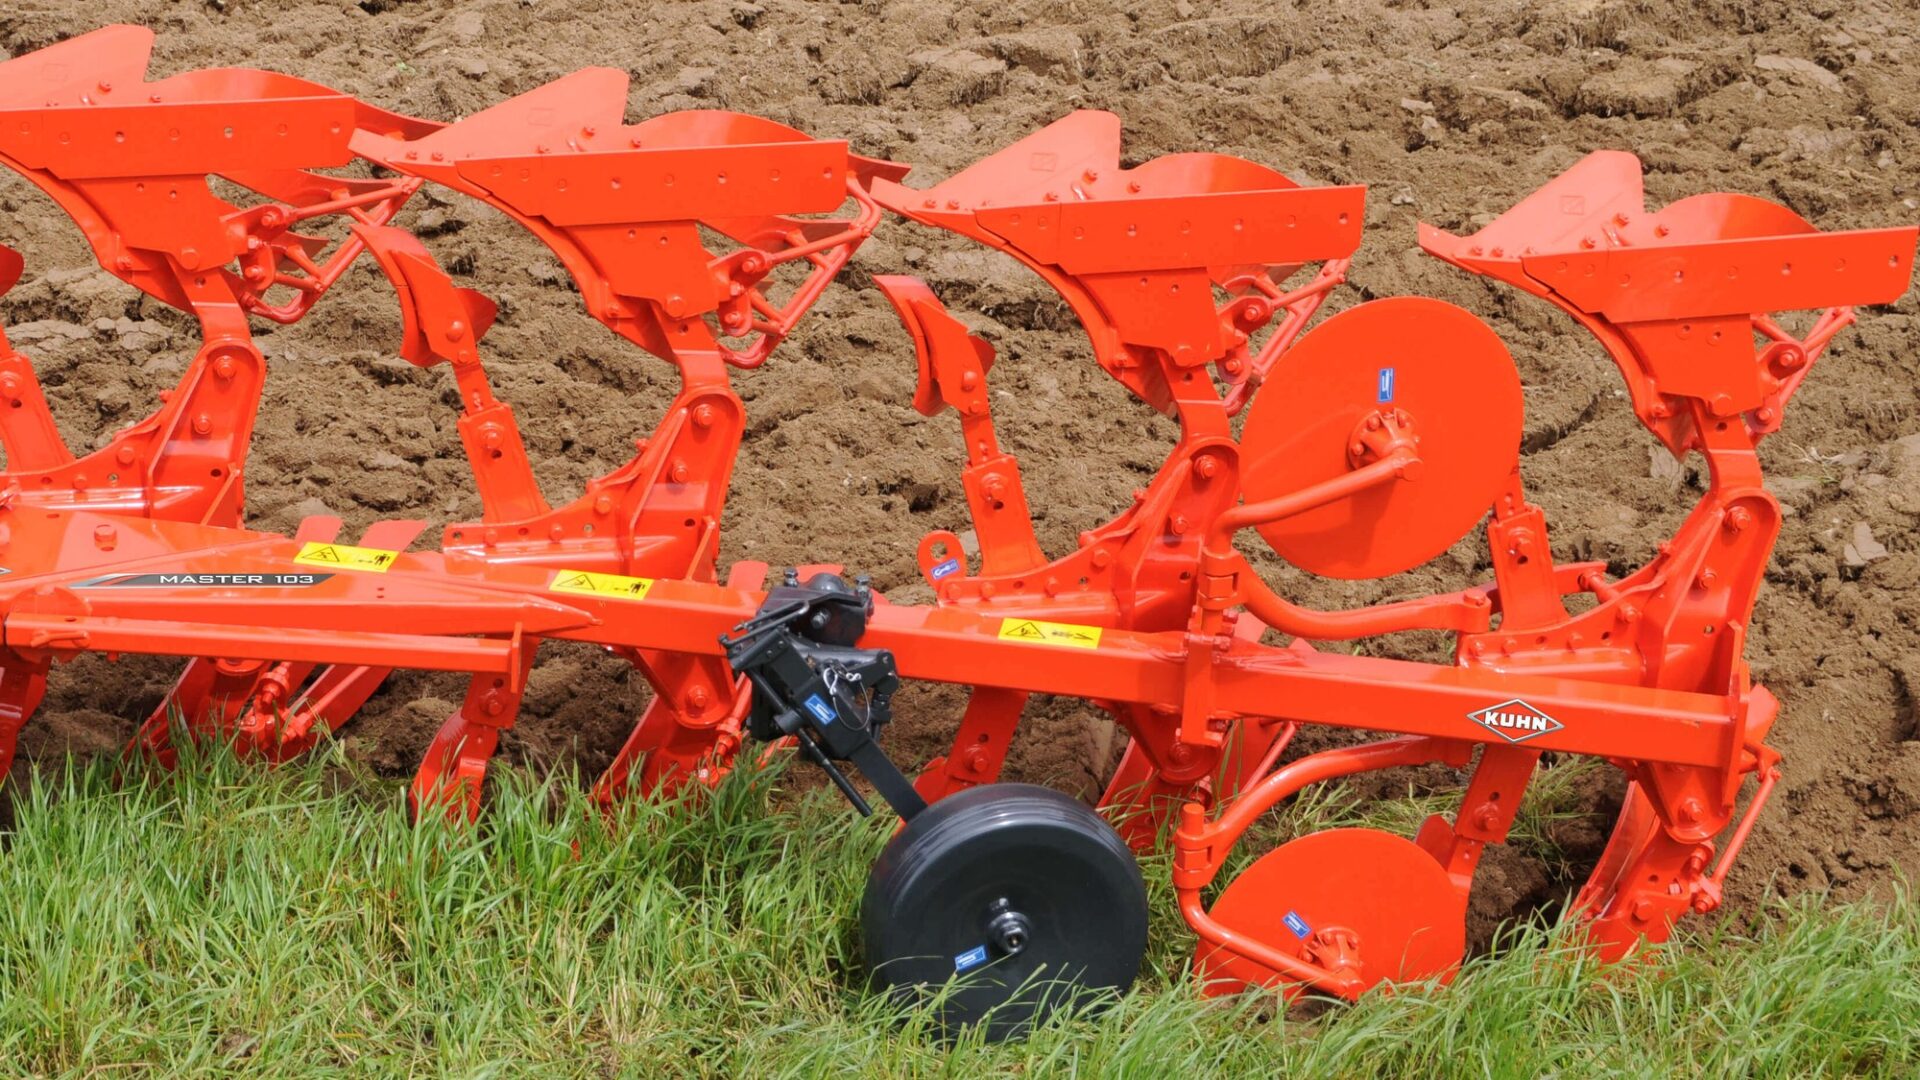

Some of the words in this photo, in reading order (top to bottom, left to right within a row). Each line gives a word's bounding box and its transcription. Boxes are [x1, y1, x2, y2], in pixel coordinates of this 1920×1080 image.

[159, 575, 264, 584] MASTER
[275, 575, 314, 584] 103
[1484, 711, 1547, 731] KUHN
